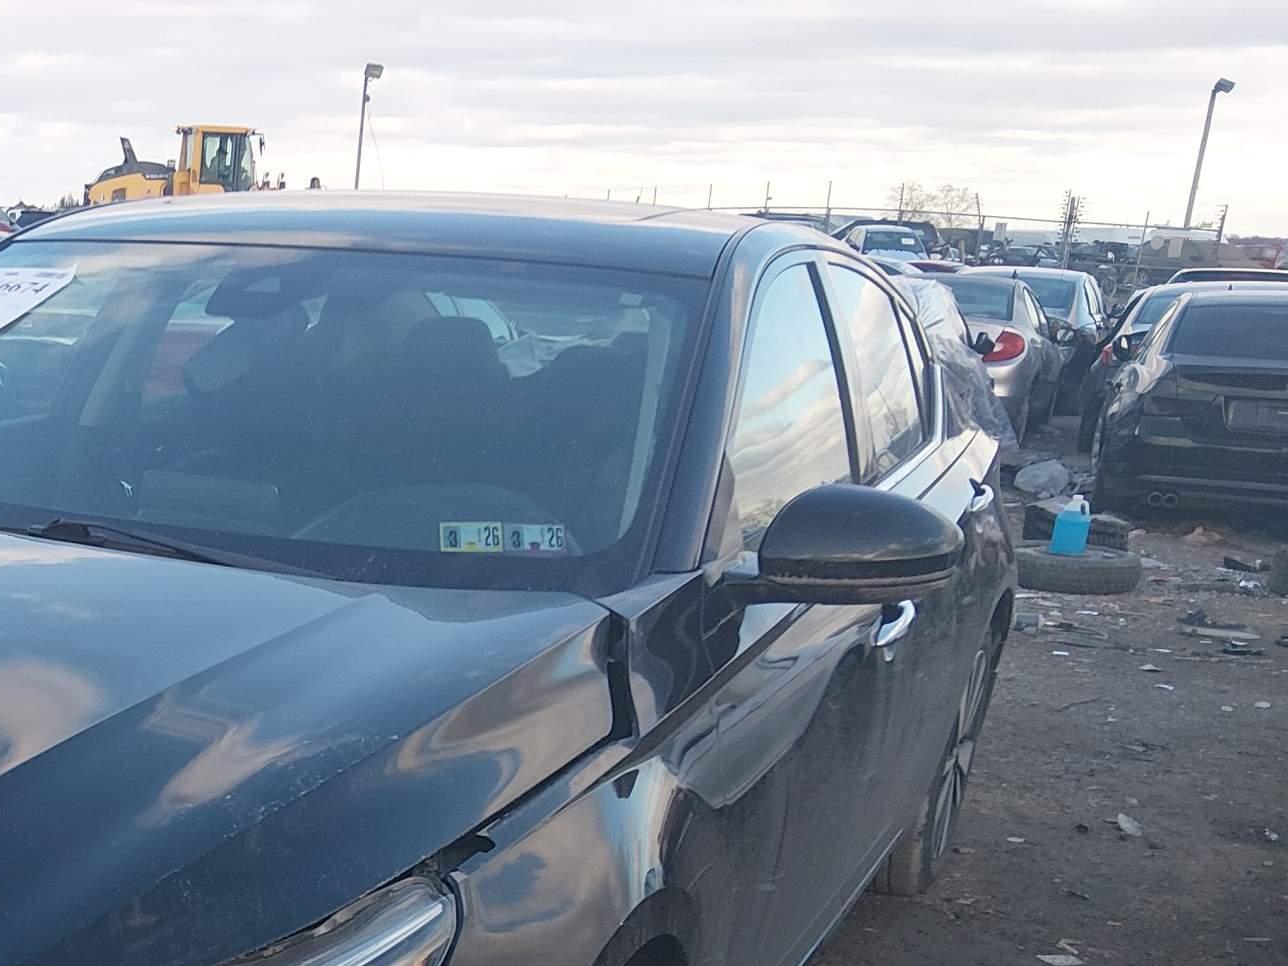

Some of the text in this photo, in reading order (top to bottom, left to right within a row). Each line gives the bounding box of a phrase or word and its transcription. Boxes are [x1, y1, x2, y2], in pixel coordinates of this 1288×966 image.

[448, 530, 459, 548] 3
[484, 526, 500, 547] 26
[547, 527, 564, 548] 26
